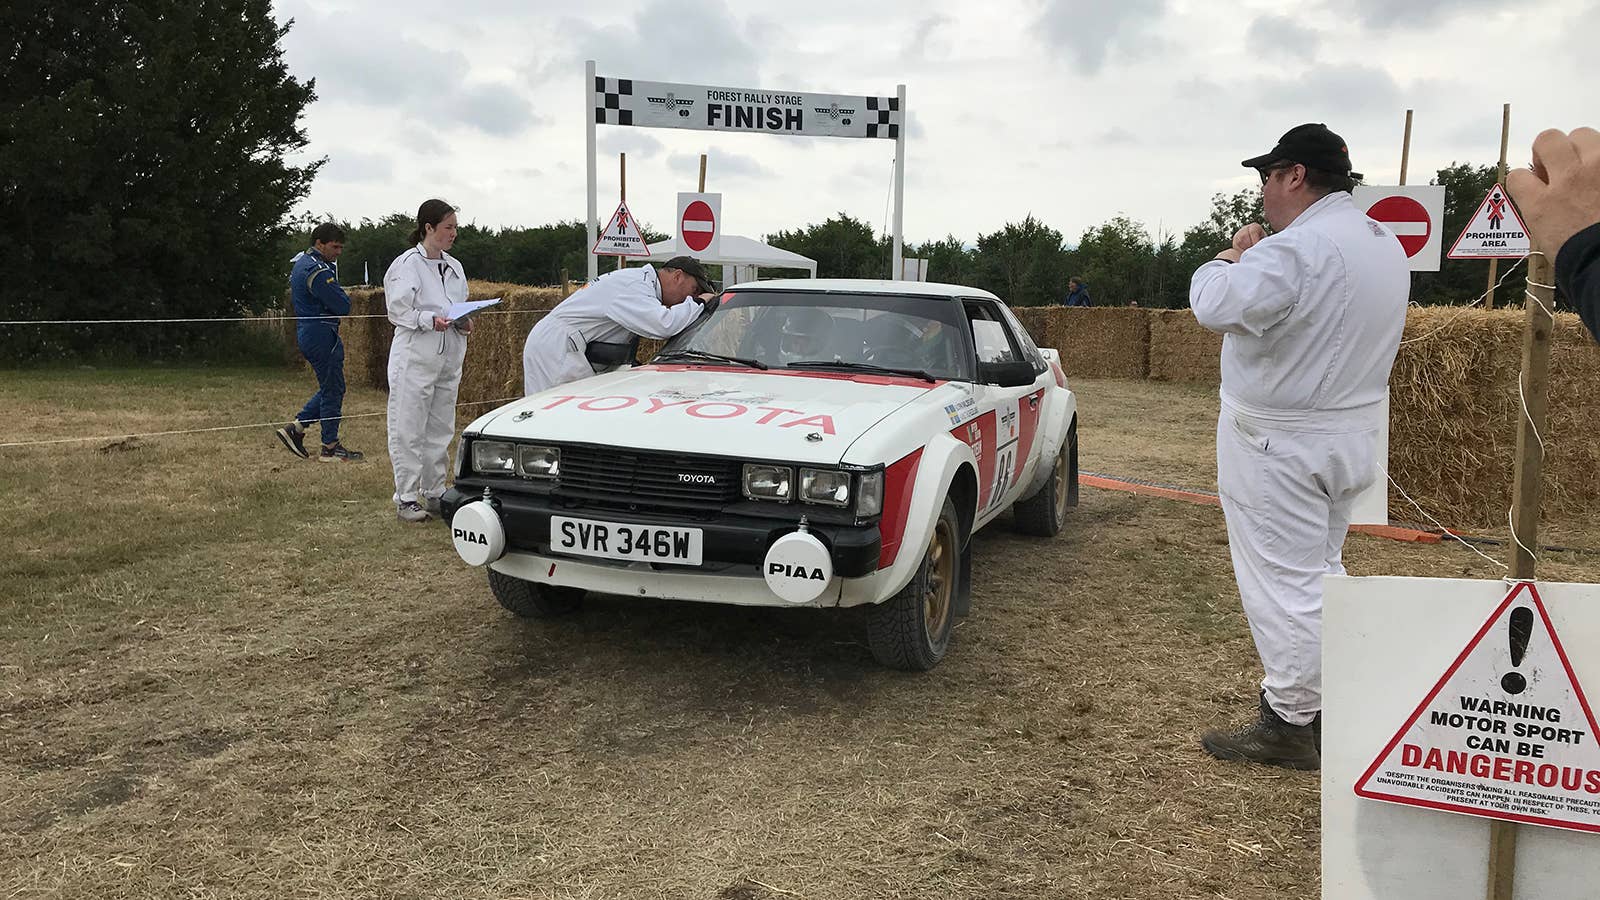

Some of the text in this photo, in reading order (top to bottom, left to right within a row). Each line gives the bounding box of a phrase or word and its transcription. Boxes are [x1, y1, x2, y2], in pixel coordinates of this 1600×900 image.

[707, 90, 802, 106] FOREST RALLY STAGE
[707, 103, 803, 131] FINISH
[541, 395, 837, 435] TOYOTA
[678, 473, 715, 484] TOYOTA
[453, 528, 489, 545] PIAA
[561, 521, 690, 559] SVR 346W
[768, 562, 826, 580] PIAA
[1460, 696, 1561, 722] WARNING
[1430, 711, 1585, 744] MOTOR SPORT
[1466, 735, 1545, 758] CAN BE
[1401, 743, 1600, 794] DANGEROUS
[1377, 777, 1424, 789] UNAVOIDABLE
[1426, 785, 1464, 796] ACCIDENTS
[1466, 790, 1481, 798] CAN
[1513, 797, 1522, 805] IN
[1523, 799, 1554, 809] RESPECT
[1416, 775, 1429, 783] THE
[1431, 777, 1476, 789] ORGANISERS
[1504, 788, 1517, 796] ALL
[1519, 791, 1565, 802] REASONABLE
[1446, 795, 1478, 805] PRESENT
[1490, 801, 1510, 810] YOUR
[1511, 804, 1528, 813] OWN
